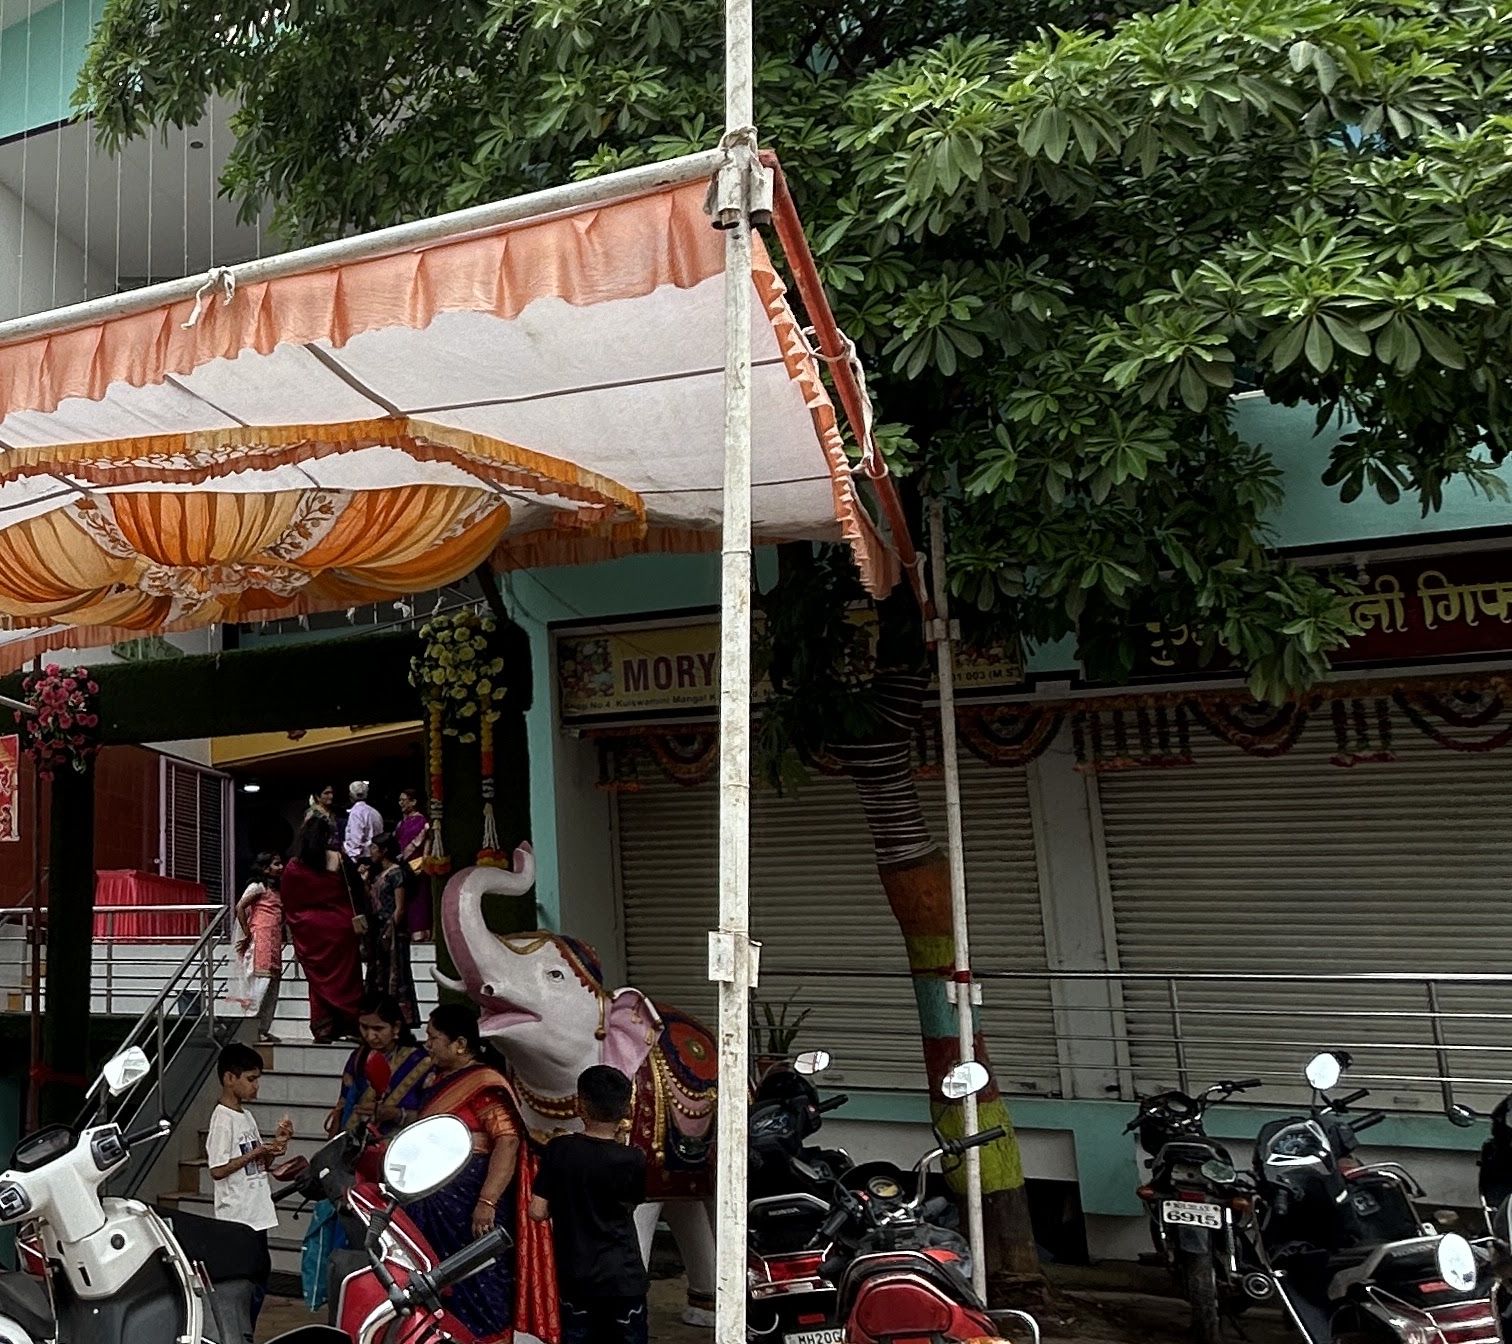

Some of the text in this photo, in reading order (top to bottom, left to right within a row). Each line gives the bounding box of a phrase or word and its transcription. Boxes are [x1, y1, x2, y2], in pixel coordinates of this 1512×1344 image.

[1415, 570, 1512, 640] गिफ
[623, 653, 717, 692] MORY
[1167, 1210, 1219, 1226] 6915
